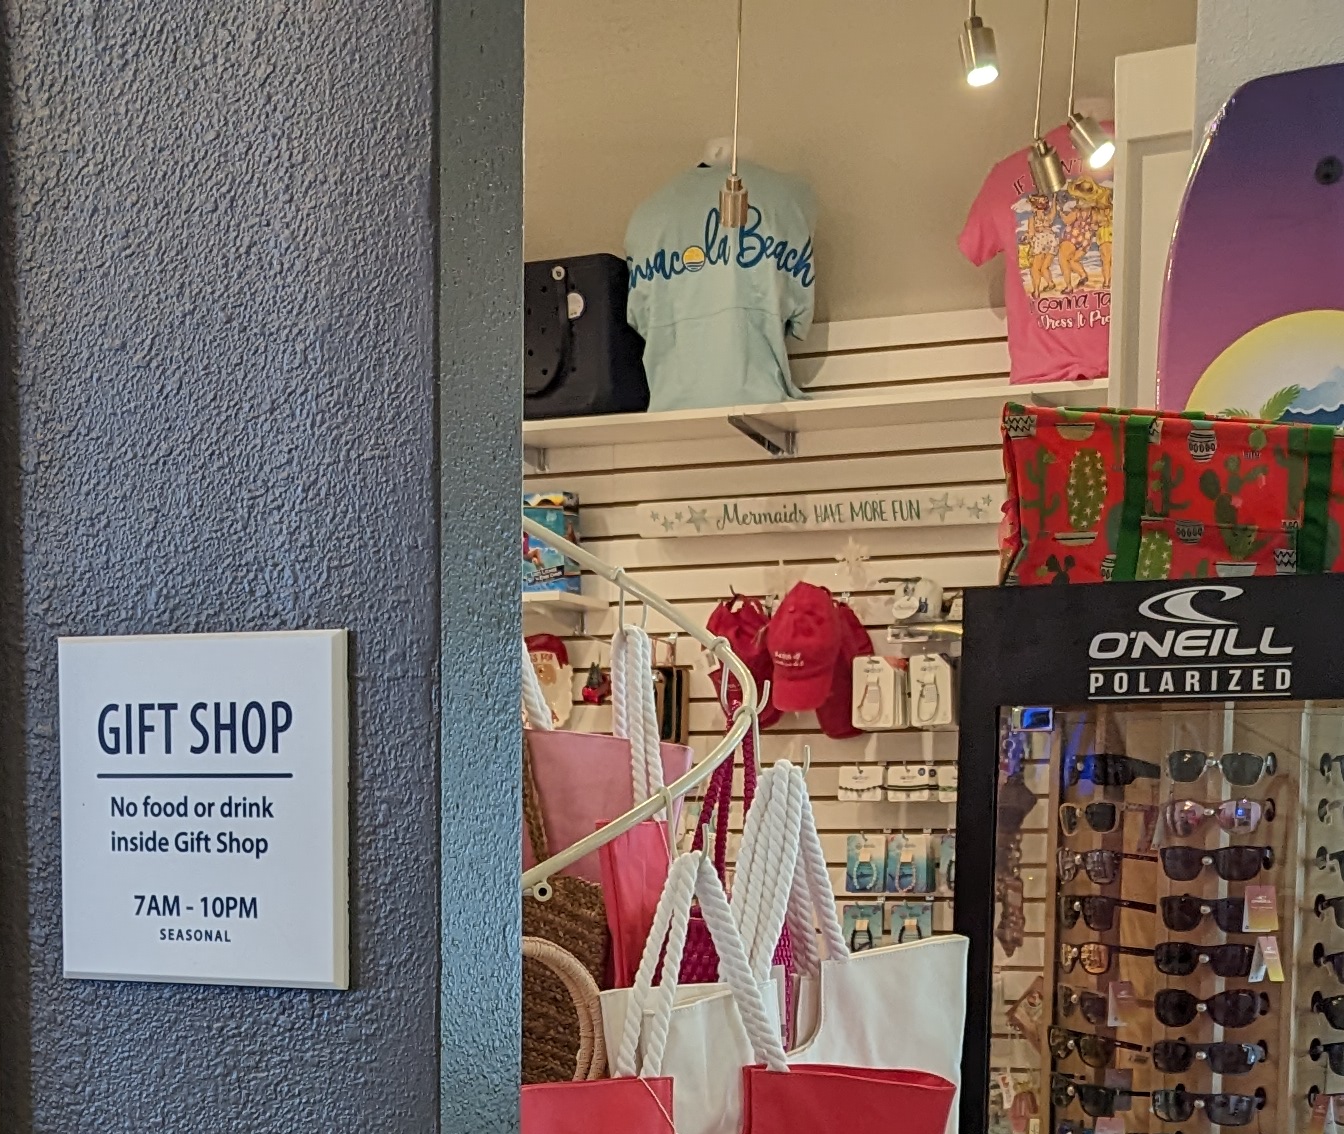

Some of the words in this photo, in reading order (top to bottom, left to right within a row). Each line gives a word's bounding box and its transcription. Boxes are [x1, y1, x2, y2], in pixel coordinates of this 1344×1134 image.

[736, 204, 816, 288] Beach
[716, 503, 807, 530] Mermaids
[813, 503, 844, 523] HAVE
[849, 501, 888, 523] MORE
[891, 499, 921, 521] FUN
[1087, 627, 1294, 660] O'NEILL
[1088, 668, 1292, 694] POLARIZED
[97, 702, 179, 755] GIFT
[189, 701, 294, 755] SHOP
[111, 797, 138, 818] No
[143, 796, 188, 818] food
[194, 801, 215, 818] or
[220, 796, 274, 819] drink
[111, 830, 169, 853] inside
[174, 831, 211, 853] Gift
[216, 831, 269, 859] Shop
[134, 895, 181, 917] 7AM
[199, 896, 259, 919] 10PM
[159, 928, 232, 943] SEASONAL
